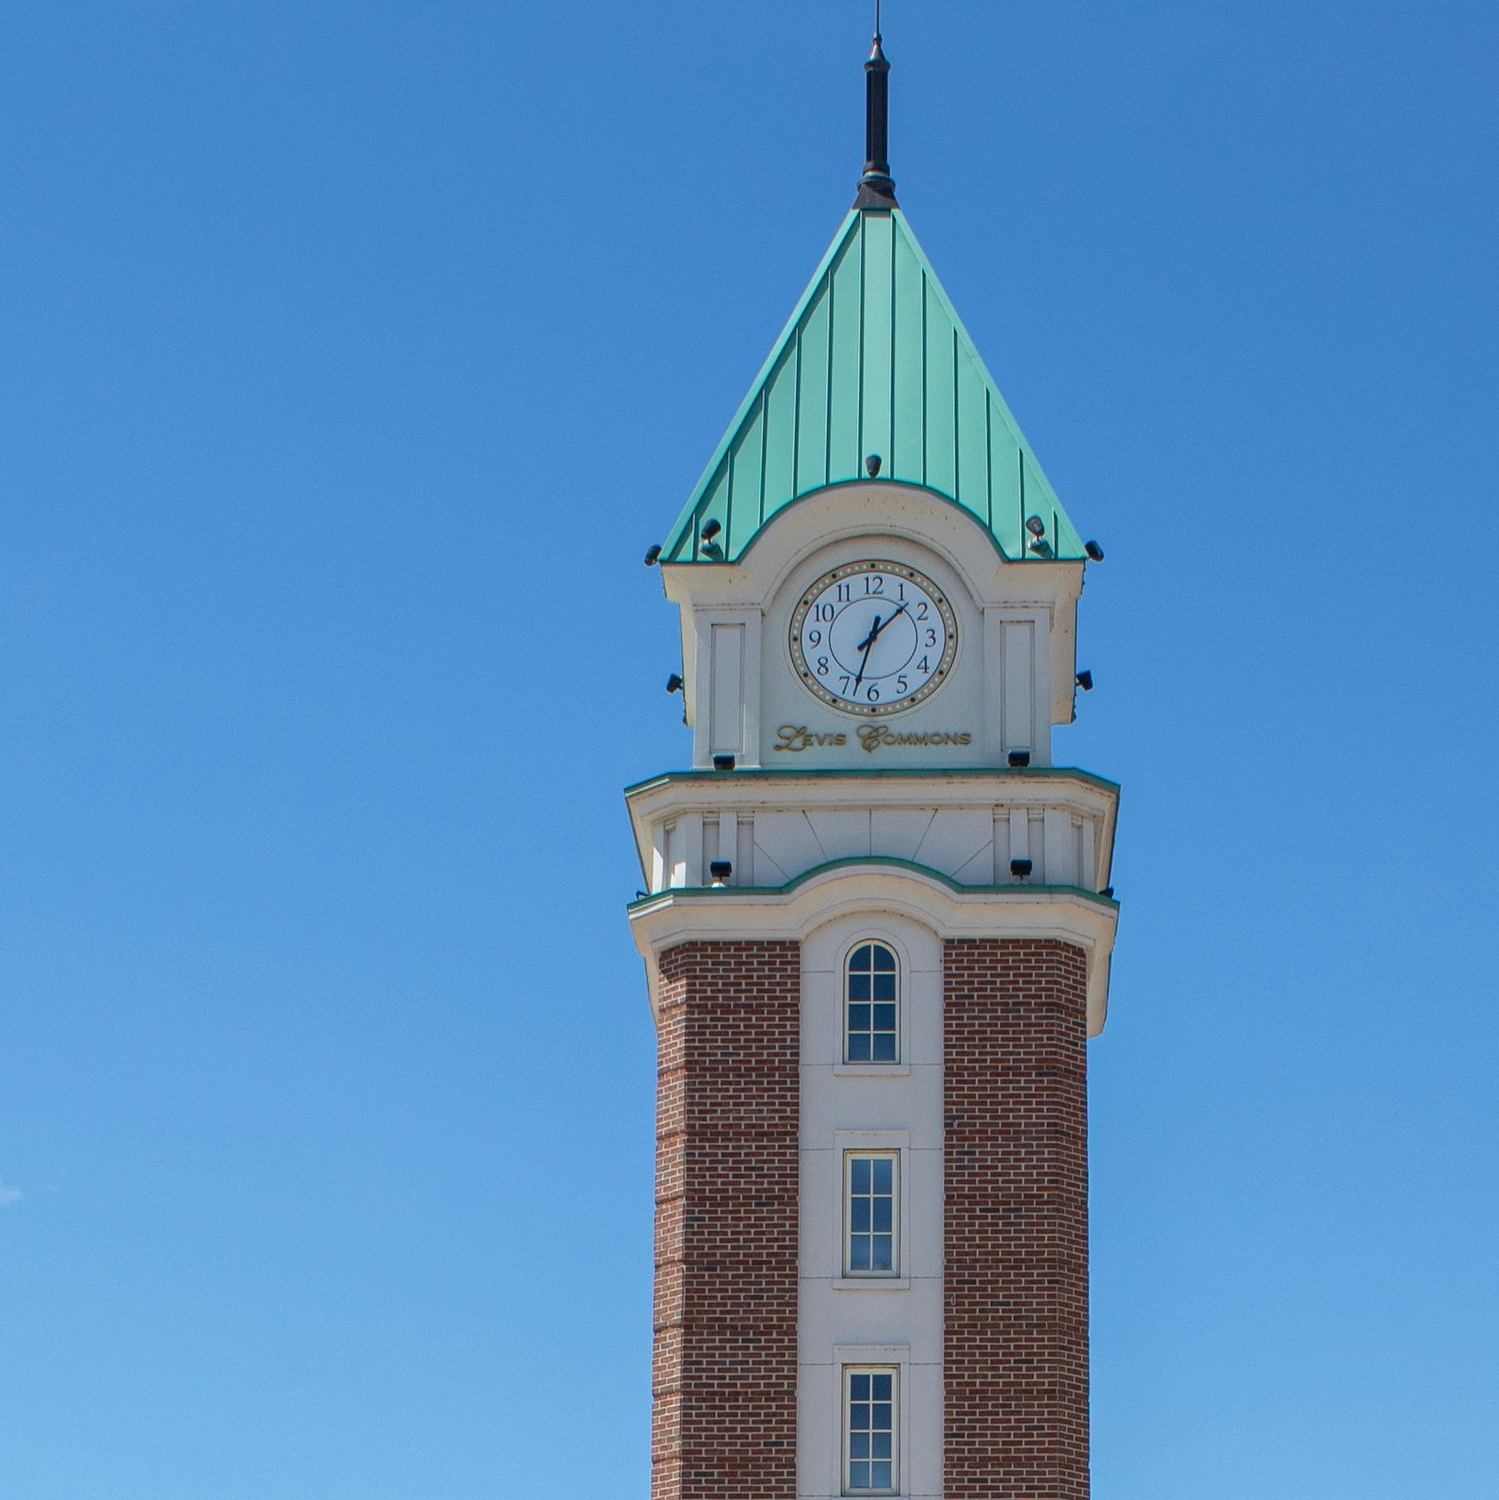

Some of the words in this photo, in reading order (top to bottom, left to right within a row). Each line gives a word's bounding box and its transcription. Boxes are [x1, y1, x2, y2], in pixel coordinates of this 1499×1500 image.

[836, 583, 851, 602] 11
[863, 576, 884, 595] 12
[898, 583, 904, 600] 1
[814, 603, 835, 623] 10
[917, 602, 929, 621] 2
[808, 629, 822, 650] 9
[925, 629, 937, 648] 3
[817, 656, 829, 676] 8
[917, 655, 930, 674] 4
[839, 676, 850, 695] 7
[867, 682, 880, 702] 6
[897, 675, 908, 694] 5
